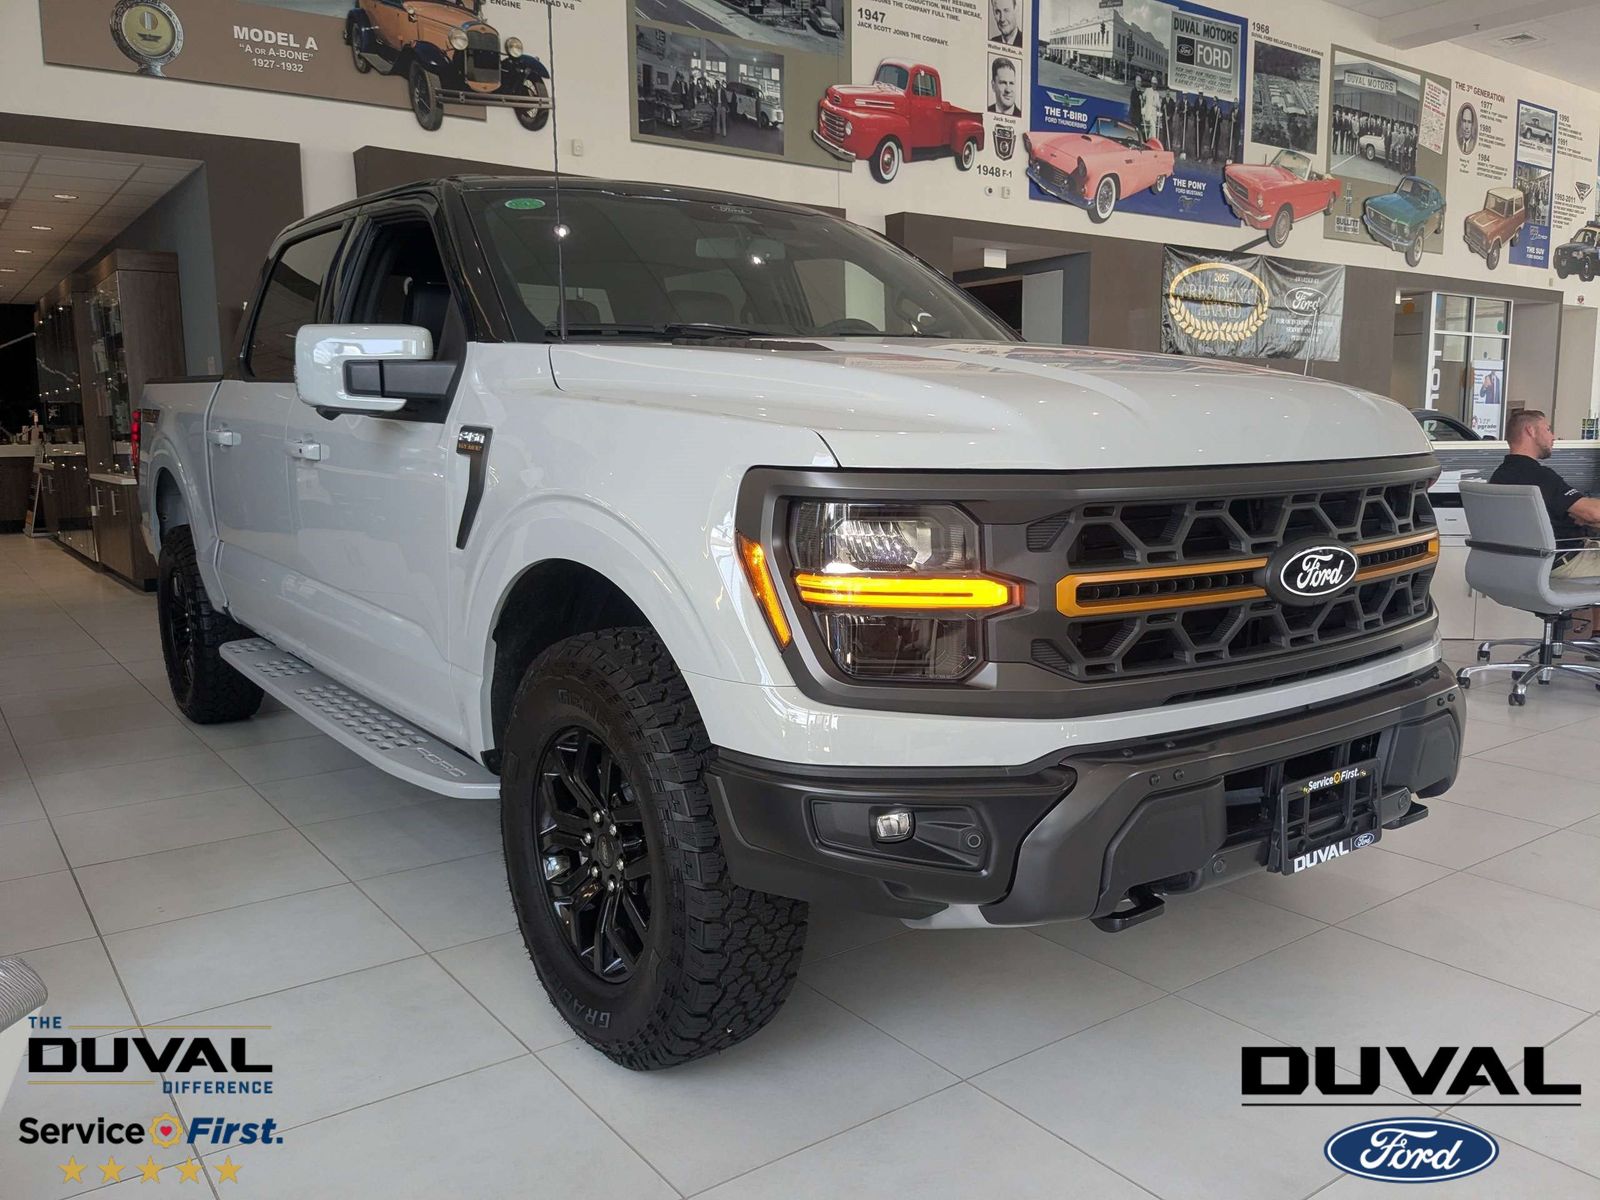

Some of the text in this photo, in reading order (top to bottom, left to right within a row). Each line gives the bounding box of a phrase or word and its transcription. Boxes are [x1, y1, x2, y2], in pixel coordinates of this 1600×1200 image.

[490, 0, 522, 10] ENGINE
[892, 1, 904, 9] THE
[904, 3, 931, 16] COMPANY
[931, 9, 945, 19] FULL
[941, 4, 962, 15] WALTER
[857, 7, 886, 23] 1947
[857, 21, 949, 47] JACK SCOTT JOINS THE COMPANY.
[1173, 16, 1239, 45] DUVAL MOTORS
[1252, 21, 1270, 35] 1968
[233, 25, 319, 51] MODEL A
[254, 47, 267, 55] OR
[1196, 44, 1232, 70] FORD
[252, 57, 304, 73] 1927-1932
[1346, 74, 1394, 92] DUVAL MOTORS
[1455, 81, 1466, 91] THE
[1473, 86, 1505, 103] GENERATION
[1480, 100, 1493, 110] 1977
[1044, 105, 1089, 123] THE T-BIRD
[1044, 116, 1088, 130] FORD THUNDERBIRD
[1478, 153, 1491, 162] 1984
[976, 164, 1013, 178] 1948 F-1
[1173, 178, 1207, 191] THE PONY
[1175, 187, 1204, 197] FORD MUSTANG
[1526, 246, 1535, 254] THE
[1292, 290, 1320, 311] Ford
[1297, 554, 1345, 590] Ford
[1308, 768, 1361, 791] Service First.
[1294, 841, 1350, 873] DUVAL
